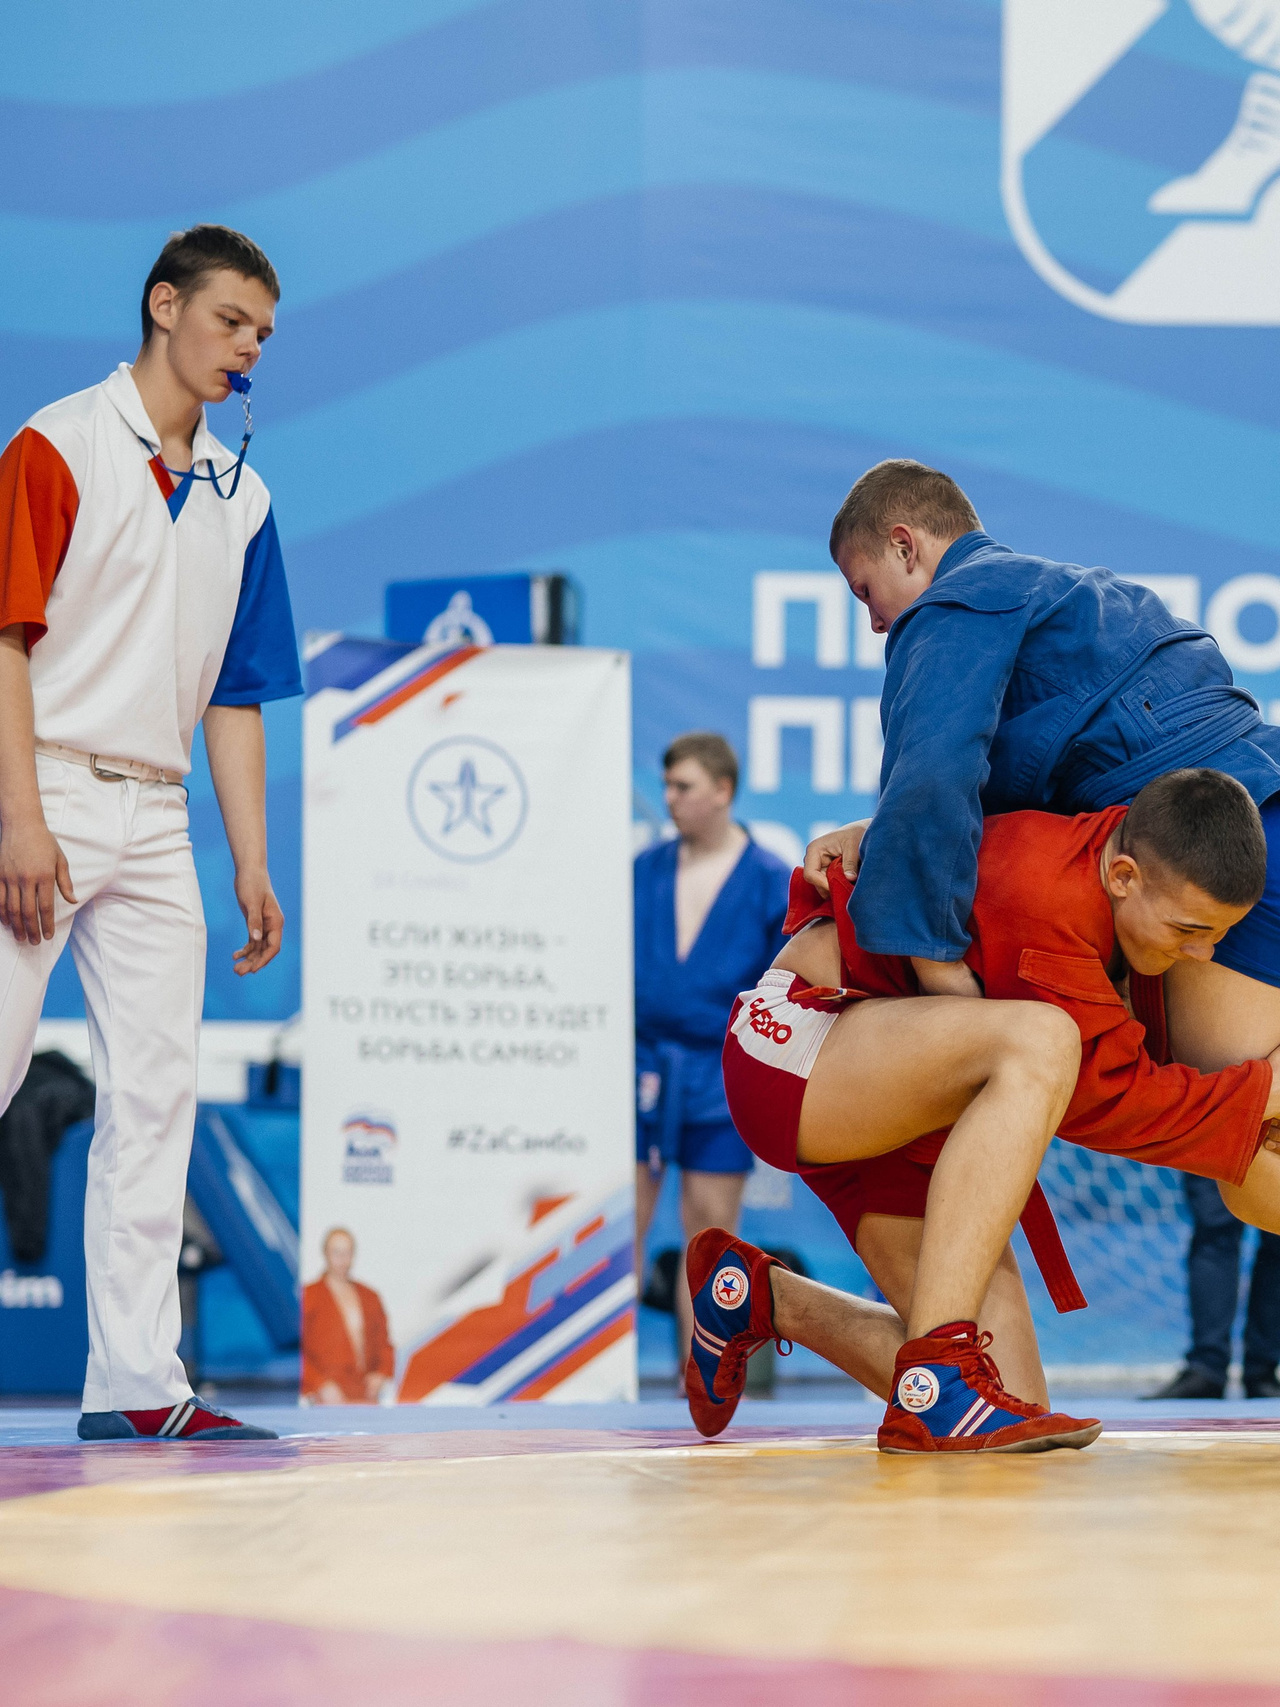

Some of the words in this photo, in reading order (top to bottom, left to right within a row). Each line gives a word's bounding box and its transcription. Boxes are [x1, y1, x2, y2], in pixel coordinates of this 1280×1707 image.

[368, 921, 442, 948] ЕСЛИ
[384, 960, 438, 987] ЭТО
[327, 996, 365, 1023] ТО
[370, 998, 460, 1026] ПУСТЬ
[466, 1001, 520, 1028] ЭТО
[525, 1004, 609, 1032] БУДЕТ
[358, 1036, 466, 1064] БОРЬБА
